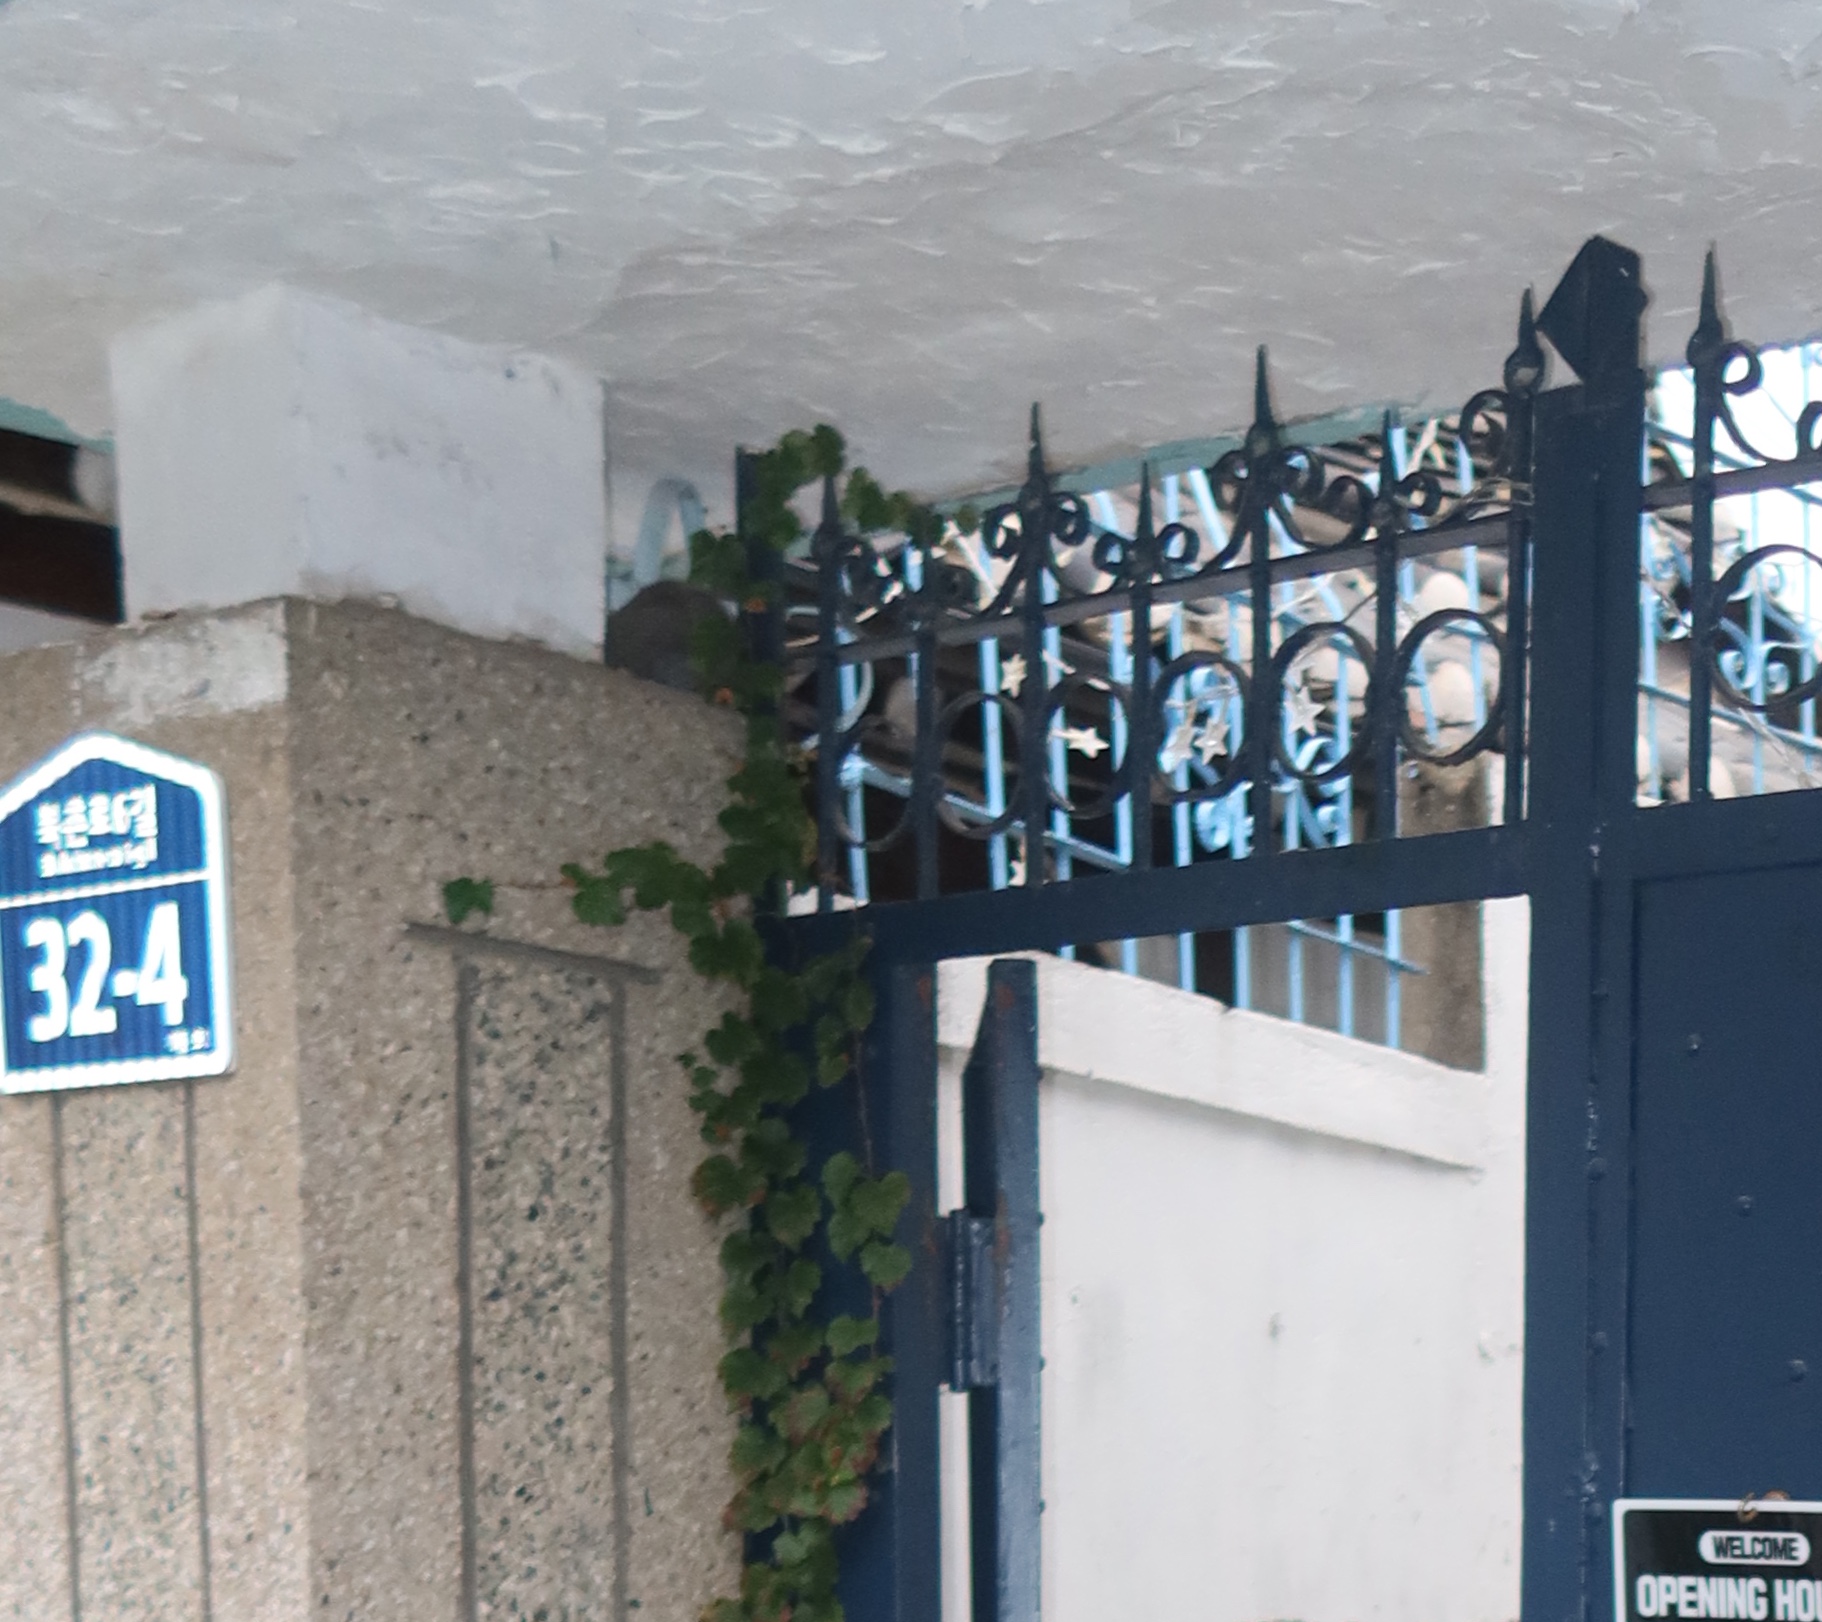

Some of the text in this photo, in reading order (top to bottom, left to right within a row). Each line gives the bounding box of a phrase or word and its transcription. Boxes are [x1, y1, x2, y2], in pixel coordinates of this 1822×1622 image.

[24, 900, 189, 1043] 32-4
[1712, 1535, 1800, 1561] WELCOME
[1636, 1573, 1769, 1622] OPENING
